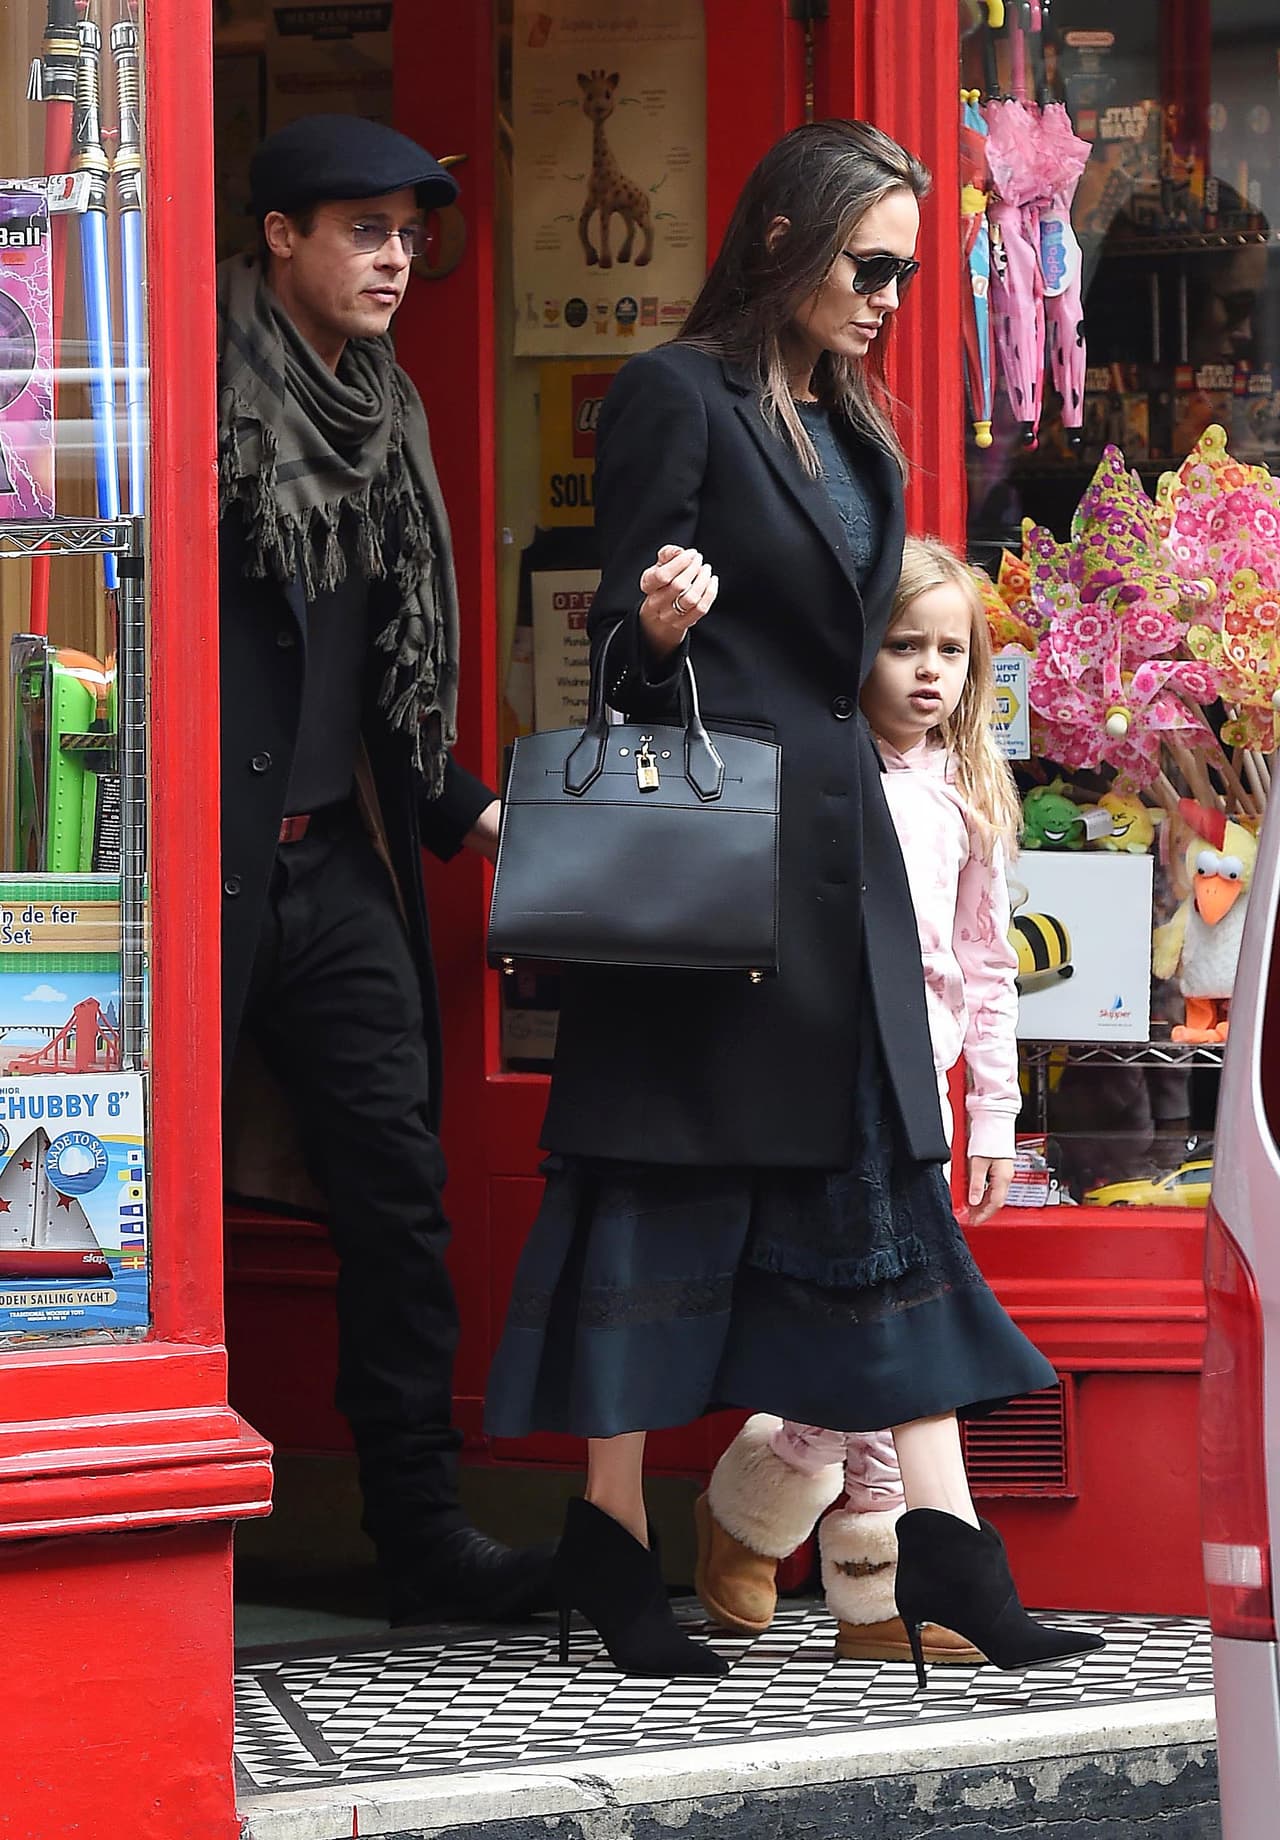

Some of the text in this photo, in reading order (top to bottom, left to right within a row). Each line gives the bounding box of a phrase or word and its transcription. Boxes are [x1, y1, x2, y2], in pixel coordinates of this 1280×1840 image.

[993, 663, 1020, 671] ured
[996, 674, 1018, 682] ADT
[22, 906, 44, 923] de
[52, 906, 77, 923] fer
[2, 926, 31, 944] Set
[48, 1133, 107, 1170] MADE TO SAIL
[30, 1293, 73, 1305] SAILING
[77, 1291, 110, 1303] YACHT
